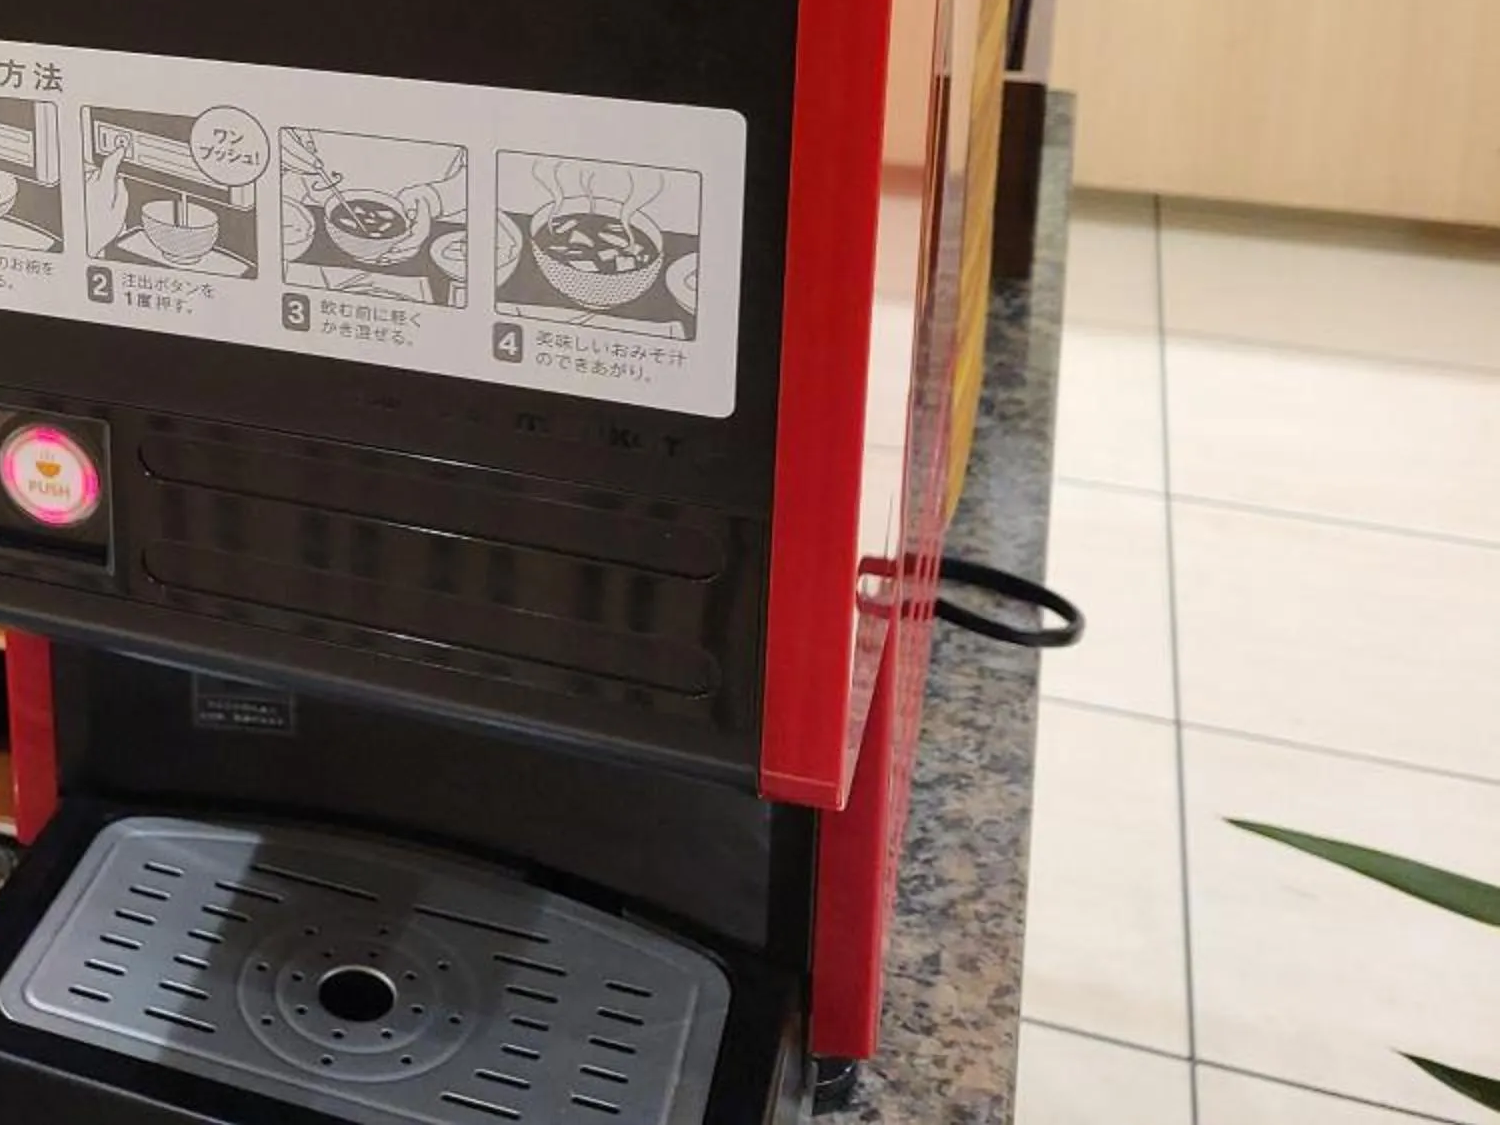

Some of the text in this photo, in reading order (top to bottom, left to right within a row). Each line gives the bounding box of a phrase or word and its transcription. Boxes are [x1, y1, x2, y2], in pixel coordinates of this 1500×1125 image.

[213, 128, 245, 145] ワン
[536, 330, 688, 368] 美味しいおみそ汁
[28, 477, 72, 499] PUSH
